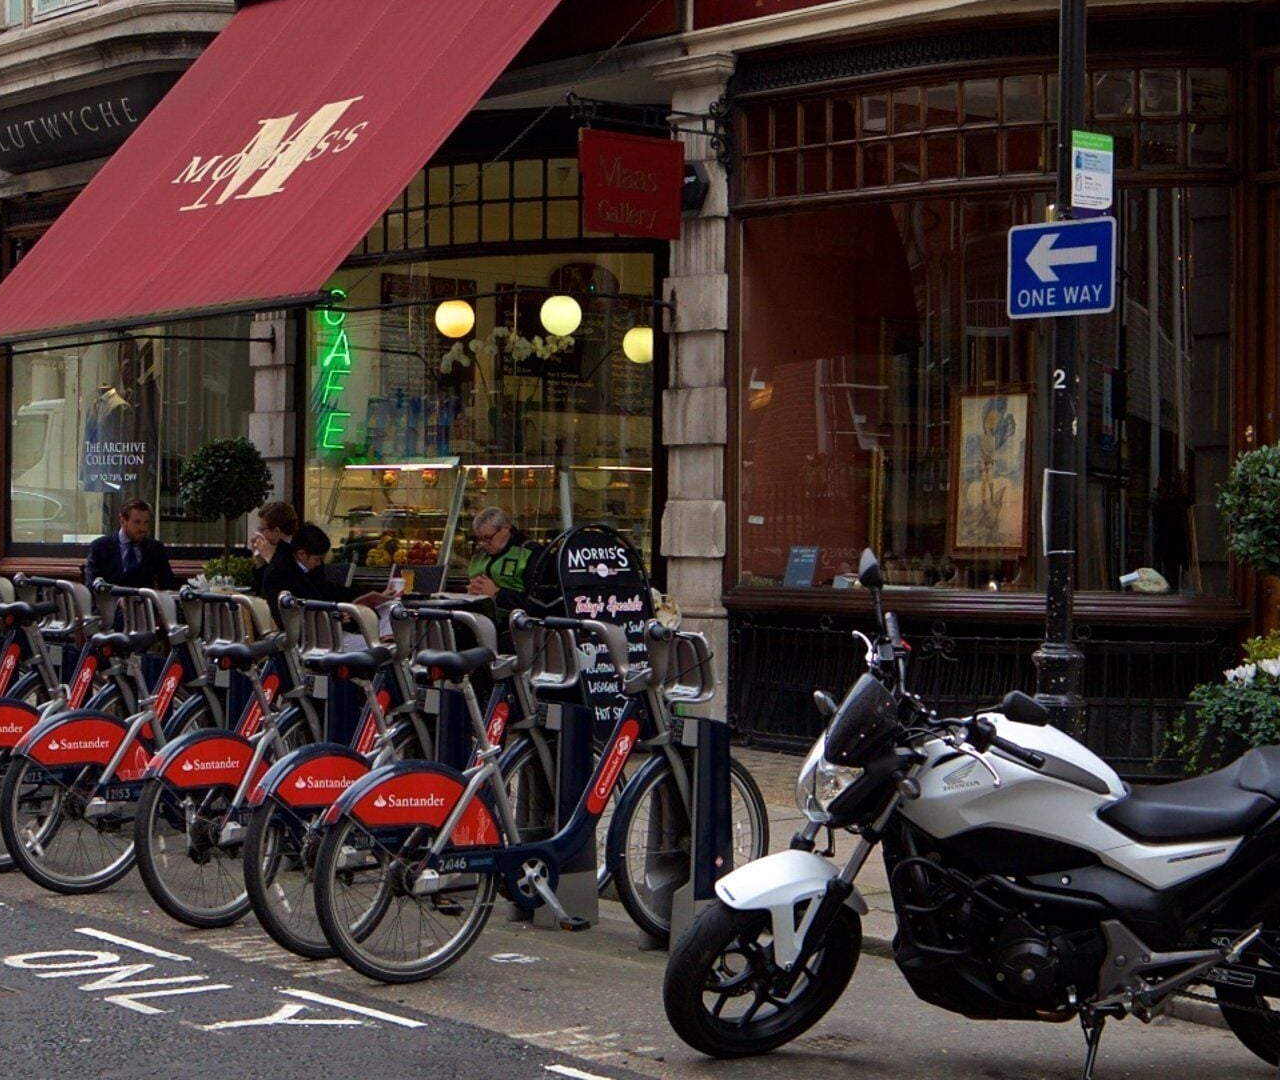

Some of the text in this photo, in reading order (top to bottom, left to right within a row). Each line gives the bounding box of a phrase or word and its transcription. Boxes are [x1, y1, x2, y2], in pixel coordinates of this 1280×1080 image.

[600, 154, 657, 192] Maas
[1017, 284, 1103, 308] ONE WAY
[323, 289, 352, 449] CAFE
[1052, 369, 1066, 389] 2
[85, 441, 146, 453] THE ARCHIVE
[86, 453, 144, 466] COLLECTION
[124, 473, 138, 481] OFF
[568, 545, 629, 568] MORRIS'S
[574, 594, 644, 619] Today's Specials
[594, 706, 610, 721] HOT
[60, 738, 110, 750] Santander
[194, 757, 240, 771] Santander
[603, 753, 621, 788] Santander
[388, 794, 445, 808] Santander
[4, 949, 363, 1032] ONLY
